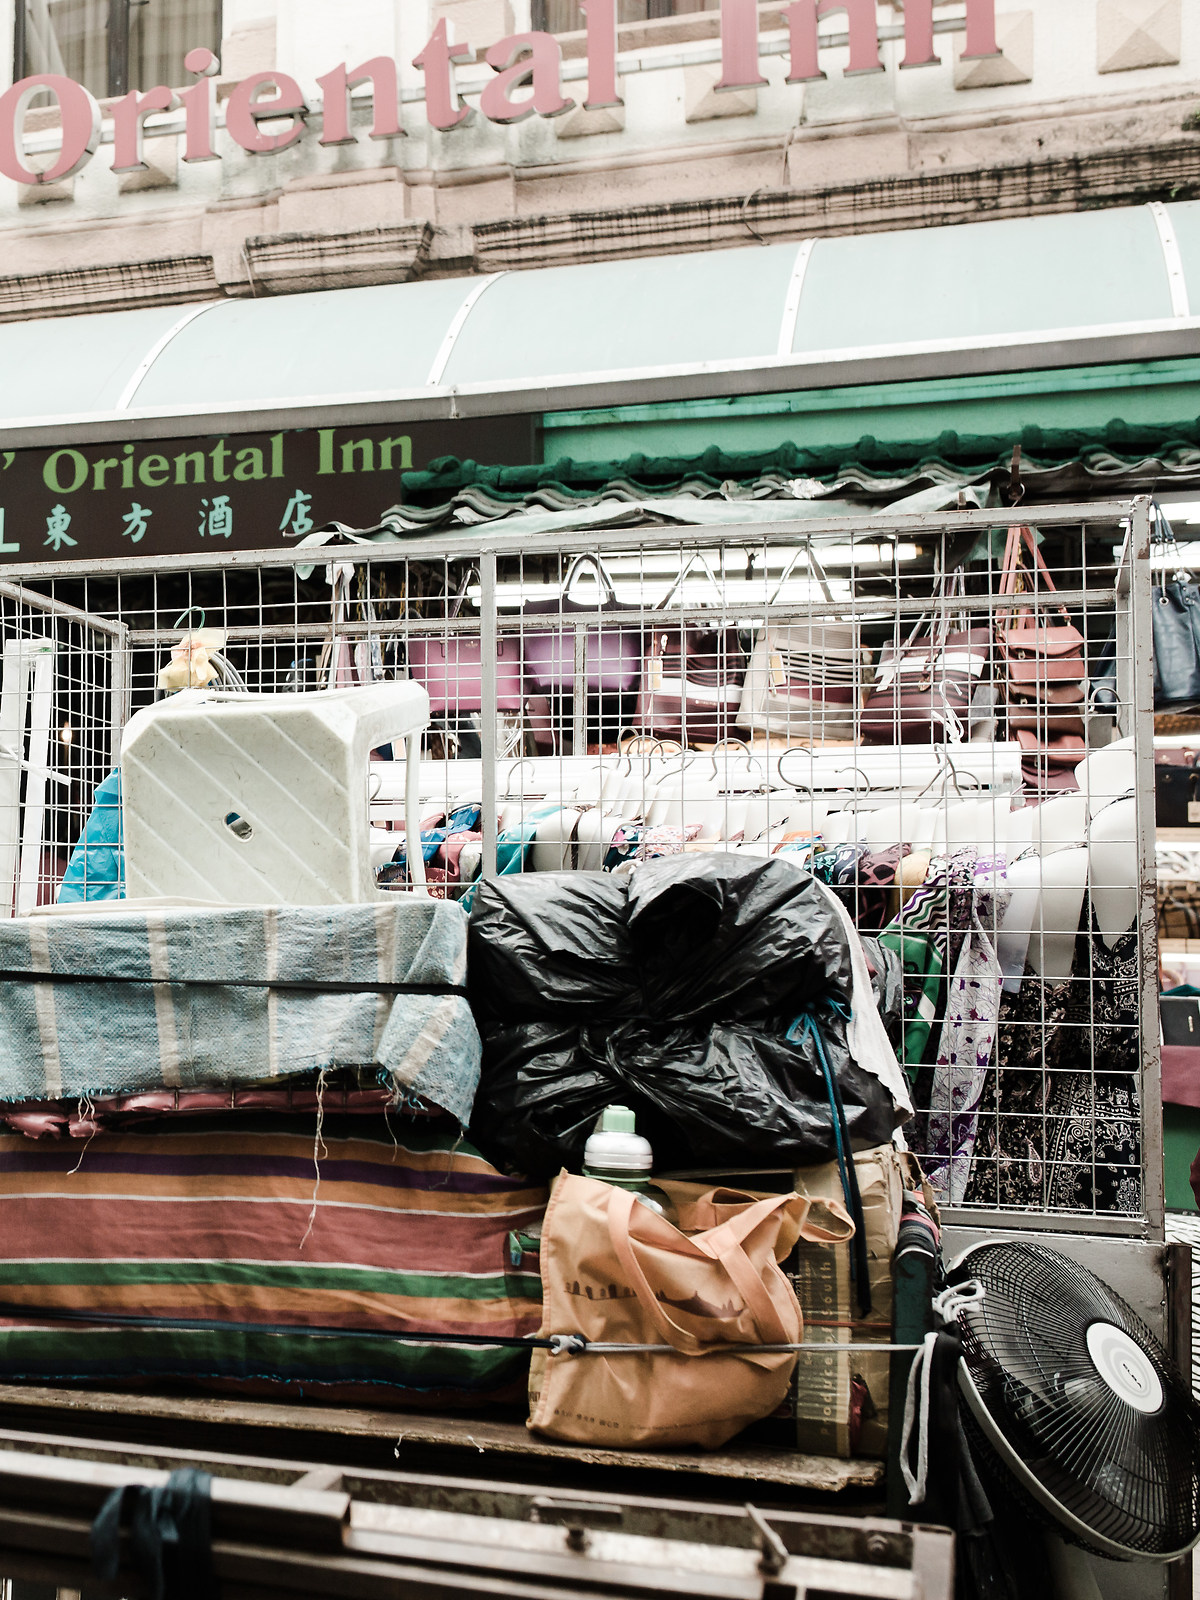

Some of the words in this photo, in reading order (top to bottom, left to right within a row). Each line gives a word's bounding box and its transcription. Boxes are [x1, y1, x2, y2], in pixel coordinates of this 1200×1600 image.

[42, 430, 285, 494] Oriental
[316, 428, 414, 475] Inn
[41, 489, 315, 552] 東方酒店
